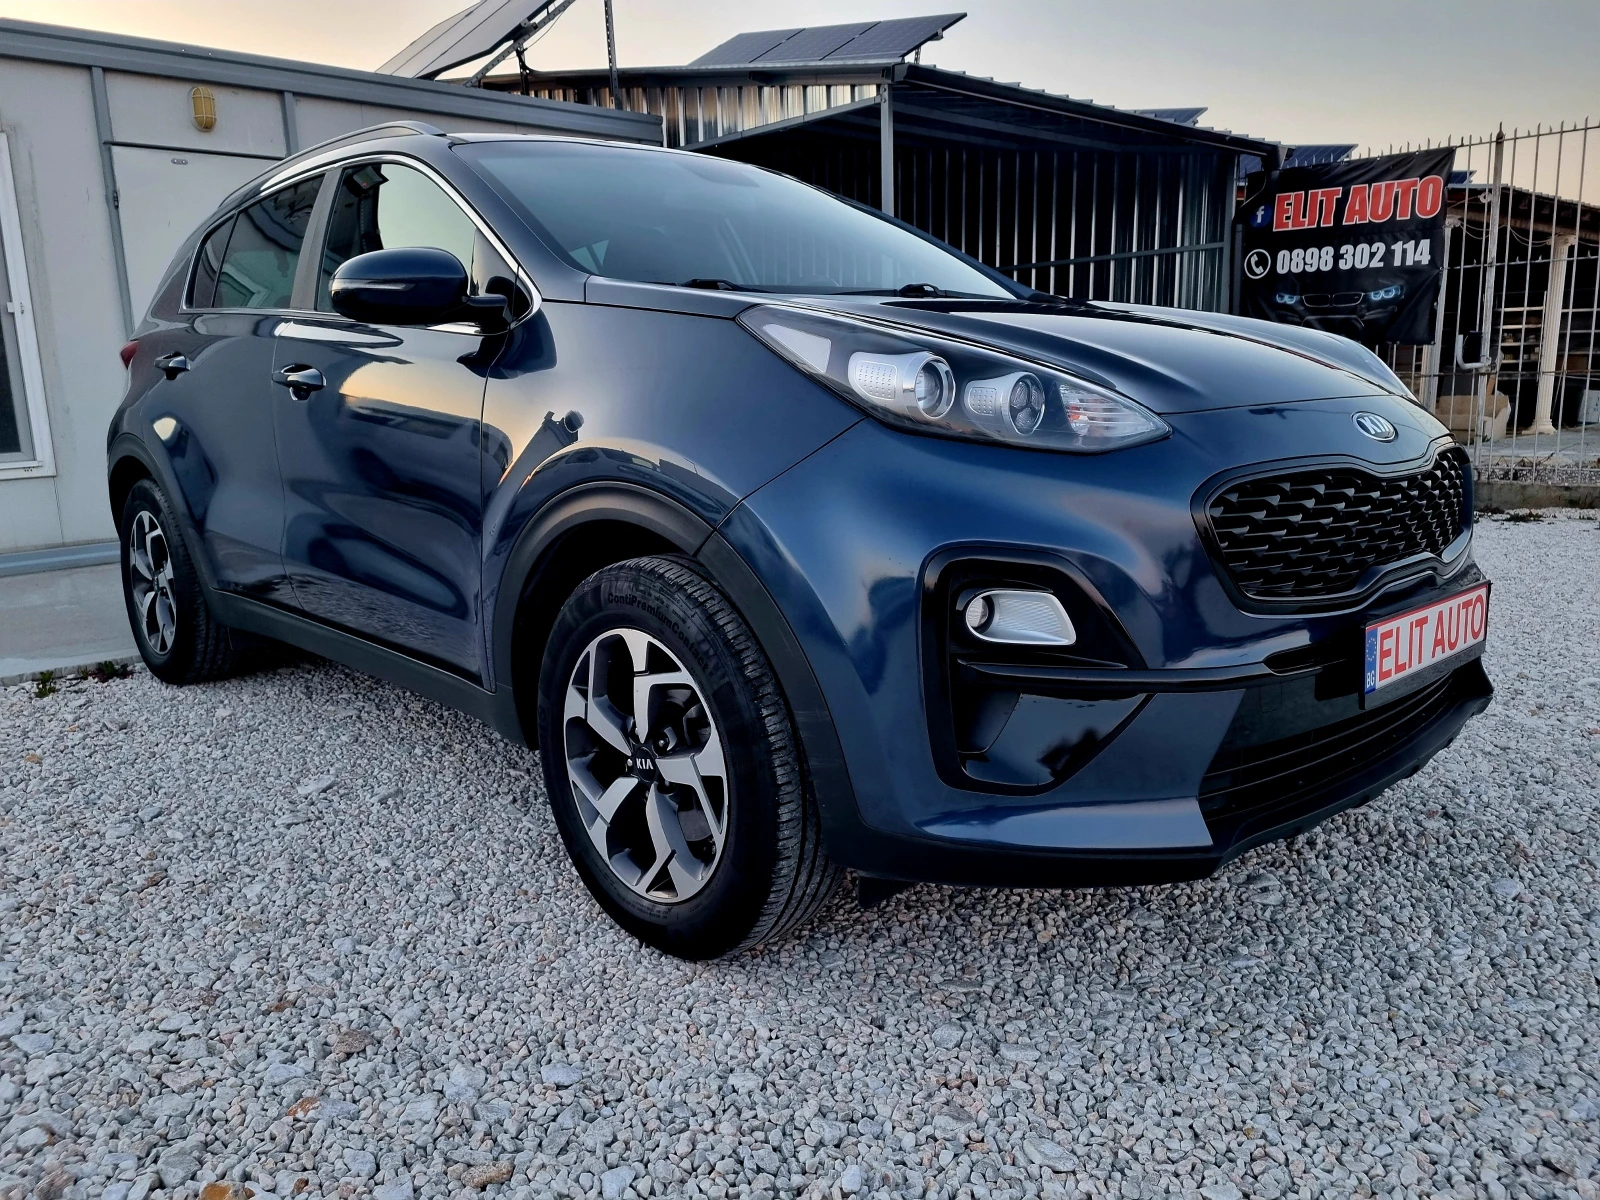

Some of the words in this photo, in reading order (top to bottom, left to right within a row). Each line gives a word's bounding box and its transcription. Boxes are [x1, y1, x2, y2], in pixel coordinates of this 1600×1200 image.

[1273, 187, 1342, 231] ELIT
[1343, 175, 1444, 225] AUTO
[1276, 246, 1334, 274] 0898
[1338, 242, 1386, 270] 302
[1391, 238, 1431, 267] 114
[607, 592, 709, 671] ContiPremiumContact
[1378, 615, 1429, 682] ELIT
[1431, 594, 1485, 659] AUTO
[1366, 670, 1375, 689] BG
[635, 757, 654, 770] KIA
